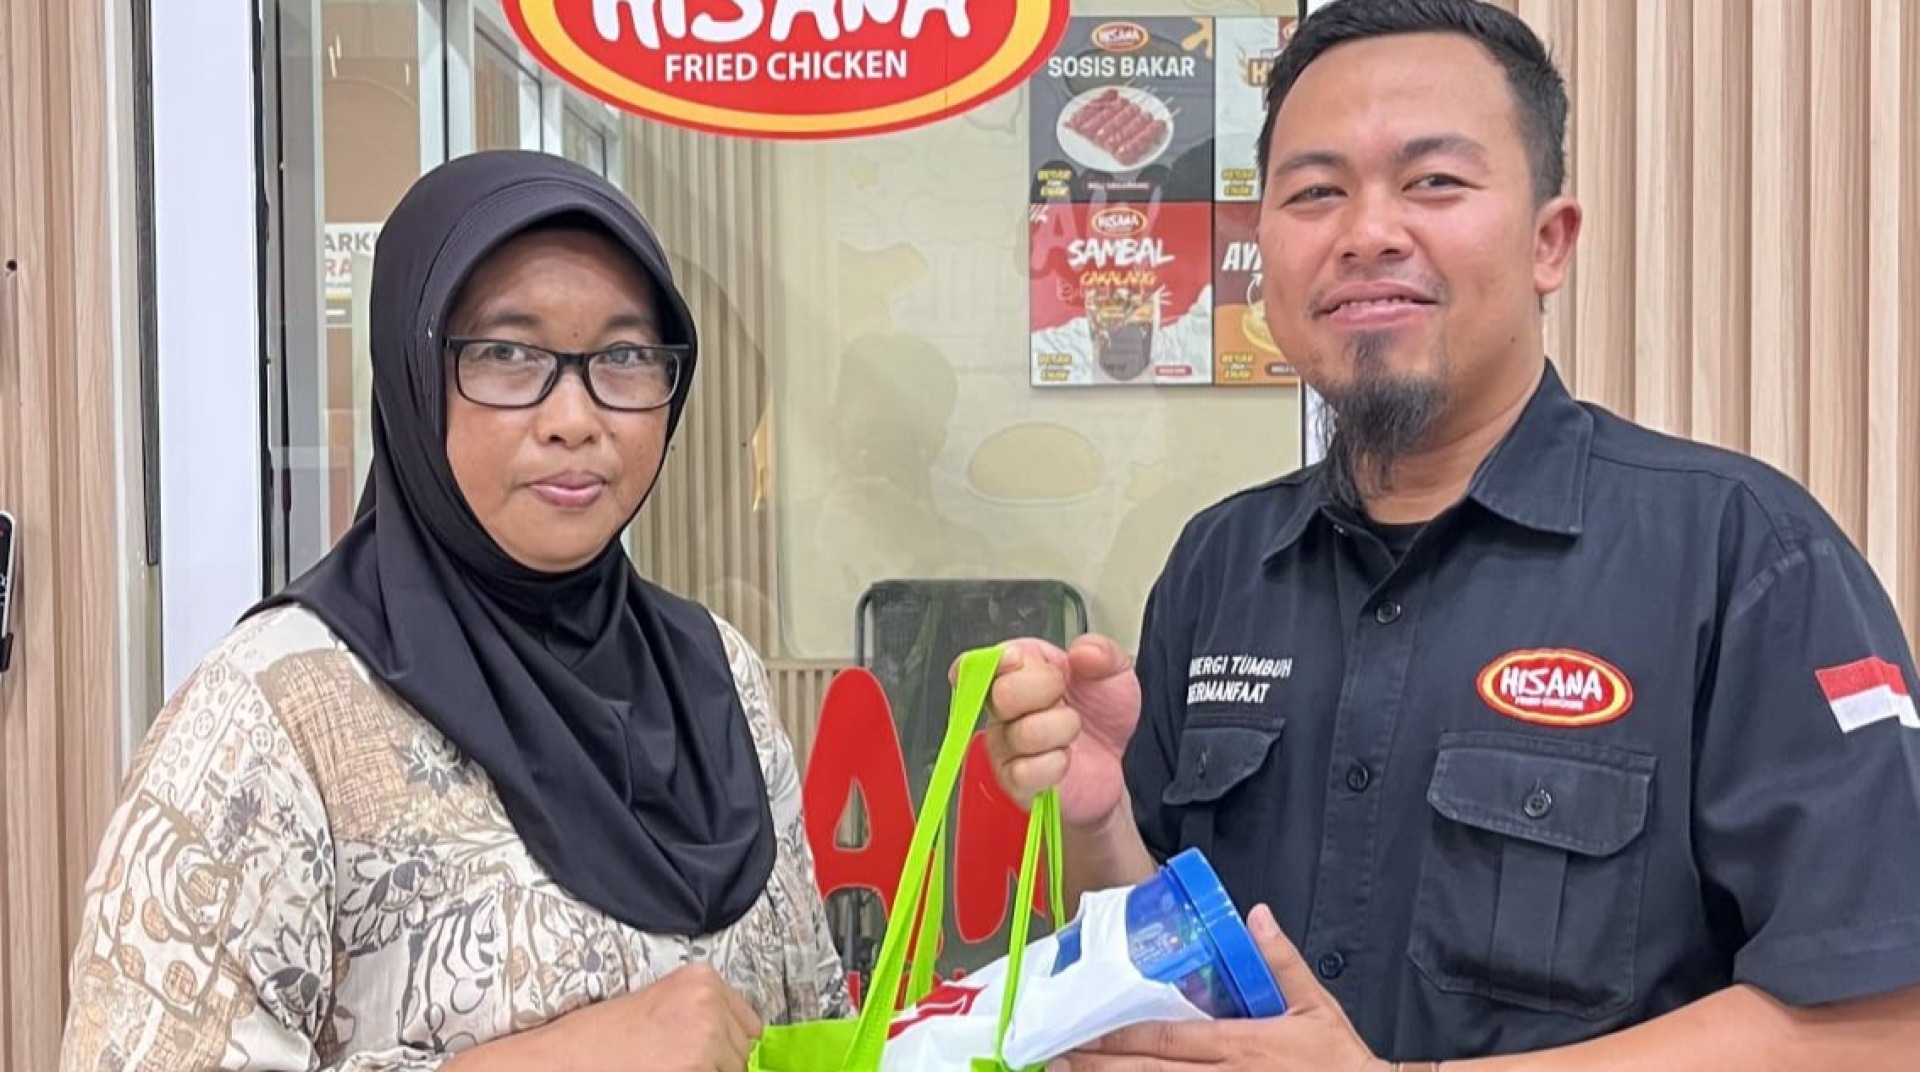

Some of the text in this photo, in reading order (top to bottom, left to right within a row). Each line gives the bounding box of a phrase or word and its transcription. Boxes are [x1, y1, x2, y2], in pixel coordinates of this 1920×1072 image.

[664, 49, 908, 83] FRIED CHICKEN
[1047, 55, 1195, 78] SOSIS BAKAR
[1067, 236, 1176, 270] SAMBAL
[1230, 654, 1293, 679] TUMBUH
[1500, 666, 1603, 702] HISANA
